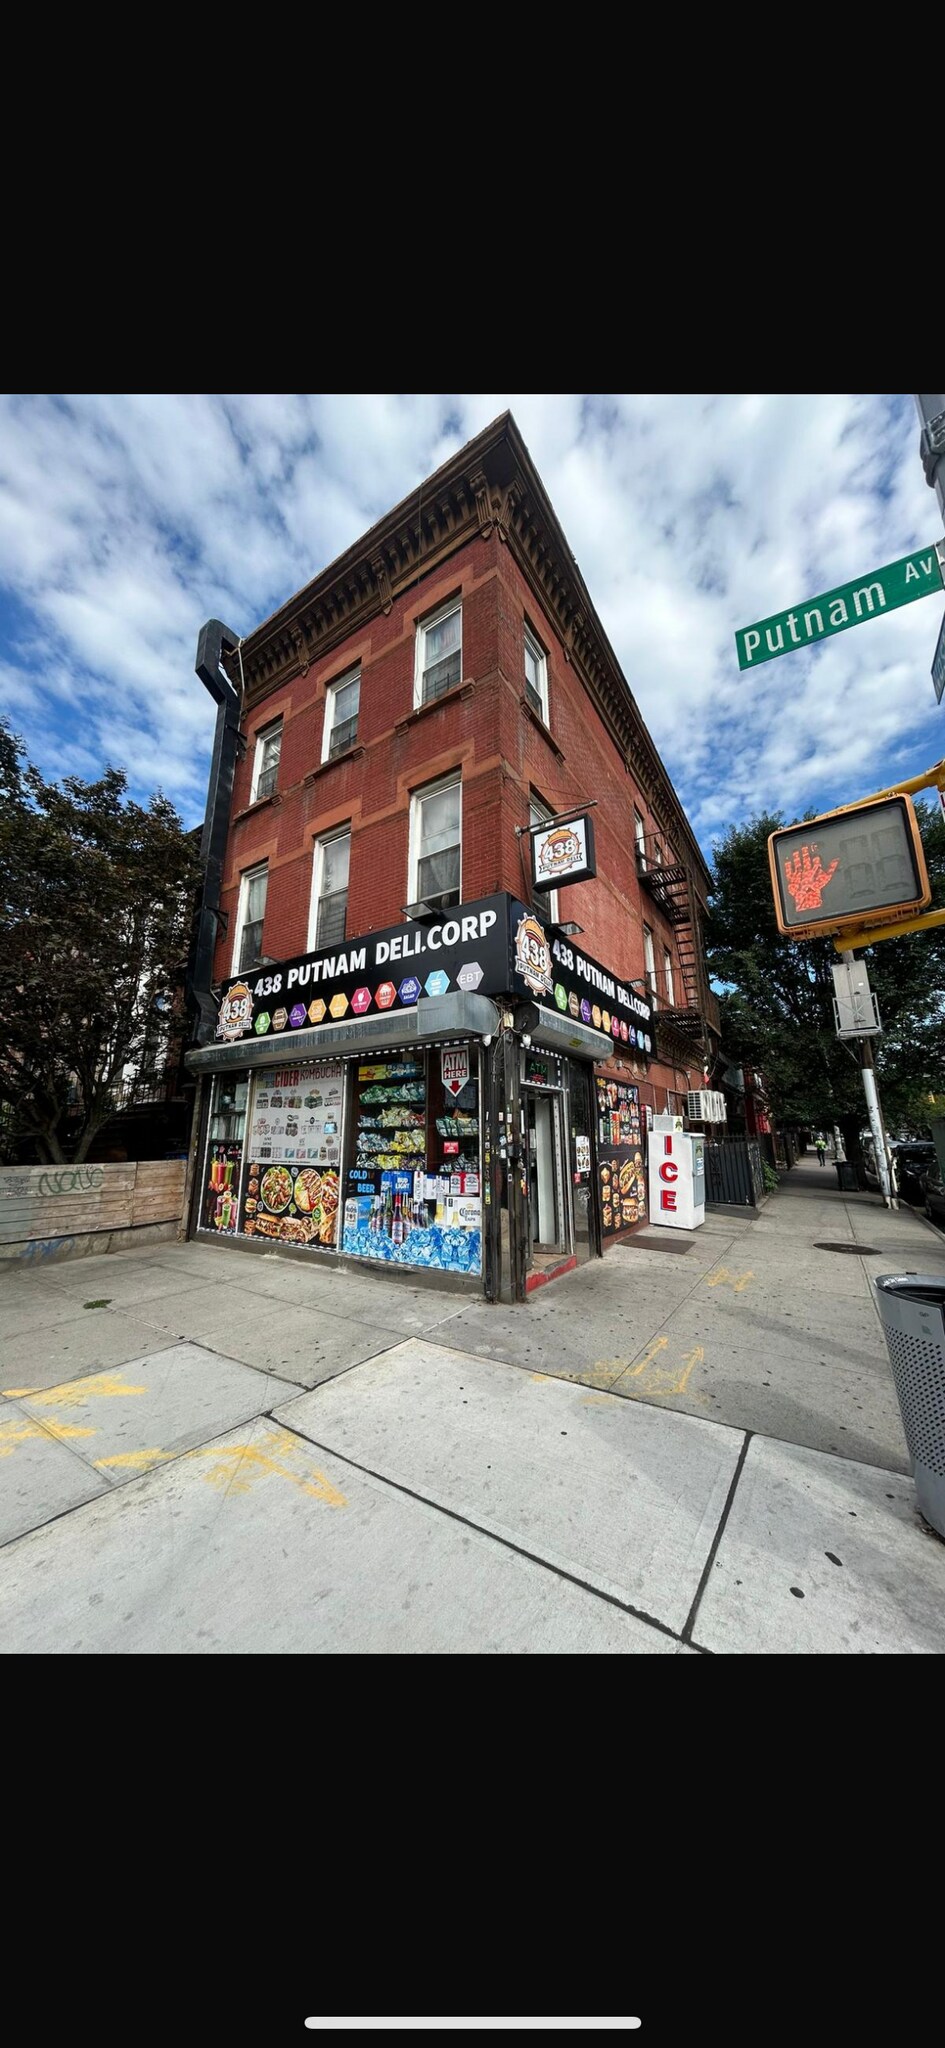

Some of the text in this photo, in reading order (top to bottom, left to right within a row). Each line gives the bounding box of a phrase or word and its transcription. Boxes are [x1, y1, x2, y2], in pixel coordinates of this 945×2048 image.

[743, 556, 933, 662] Putnam Av
[544, 838, 576, 861] 438
[543, 859, 566, 870] PUTNAM
[254, 909, 498, 997] 438 PUTNAM DELI.CORP
[521, 935, 548, 971] 438
[460, 971, 481, 984] EBT
[519, 962, 540, 979] PUTNAM
[552, 938, 575, 971] 438
[576, 955, 616, 999] PUTNAM
[223, 998, 248, 1021] 438
[443, 1052, 467, 1072] ATM
[529, 1062, 548, 1074] ATM
[275, 1069, 300, 1088] CIDER
[300, 1064, 342, 1082] KOMBUCHA
[444, 1069, 468, 1080] HERE
[349, 1170, 368, 1180] COLD
[659, 1135, 679, 1212] ICE
[357, 1183, 376, 1194] BEER
[459, 1207, 481, 1217] Corona
